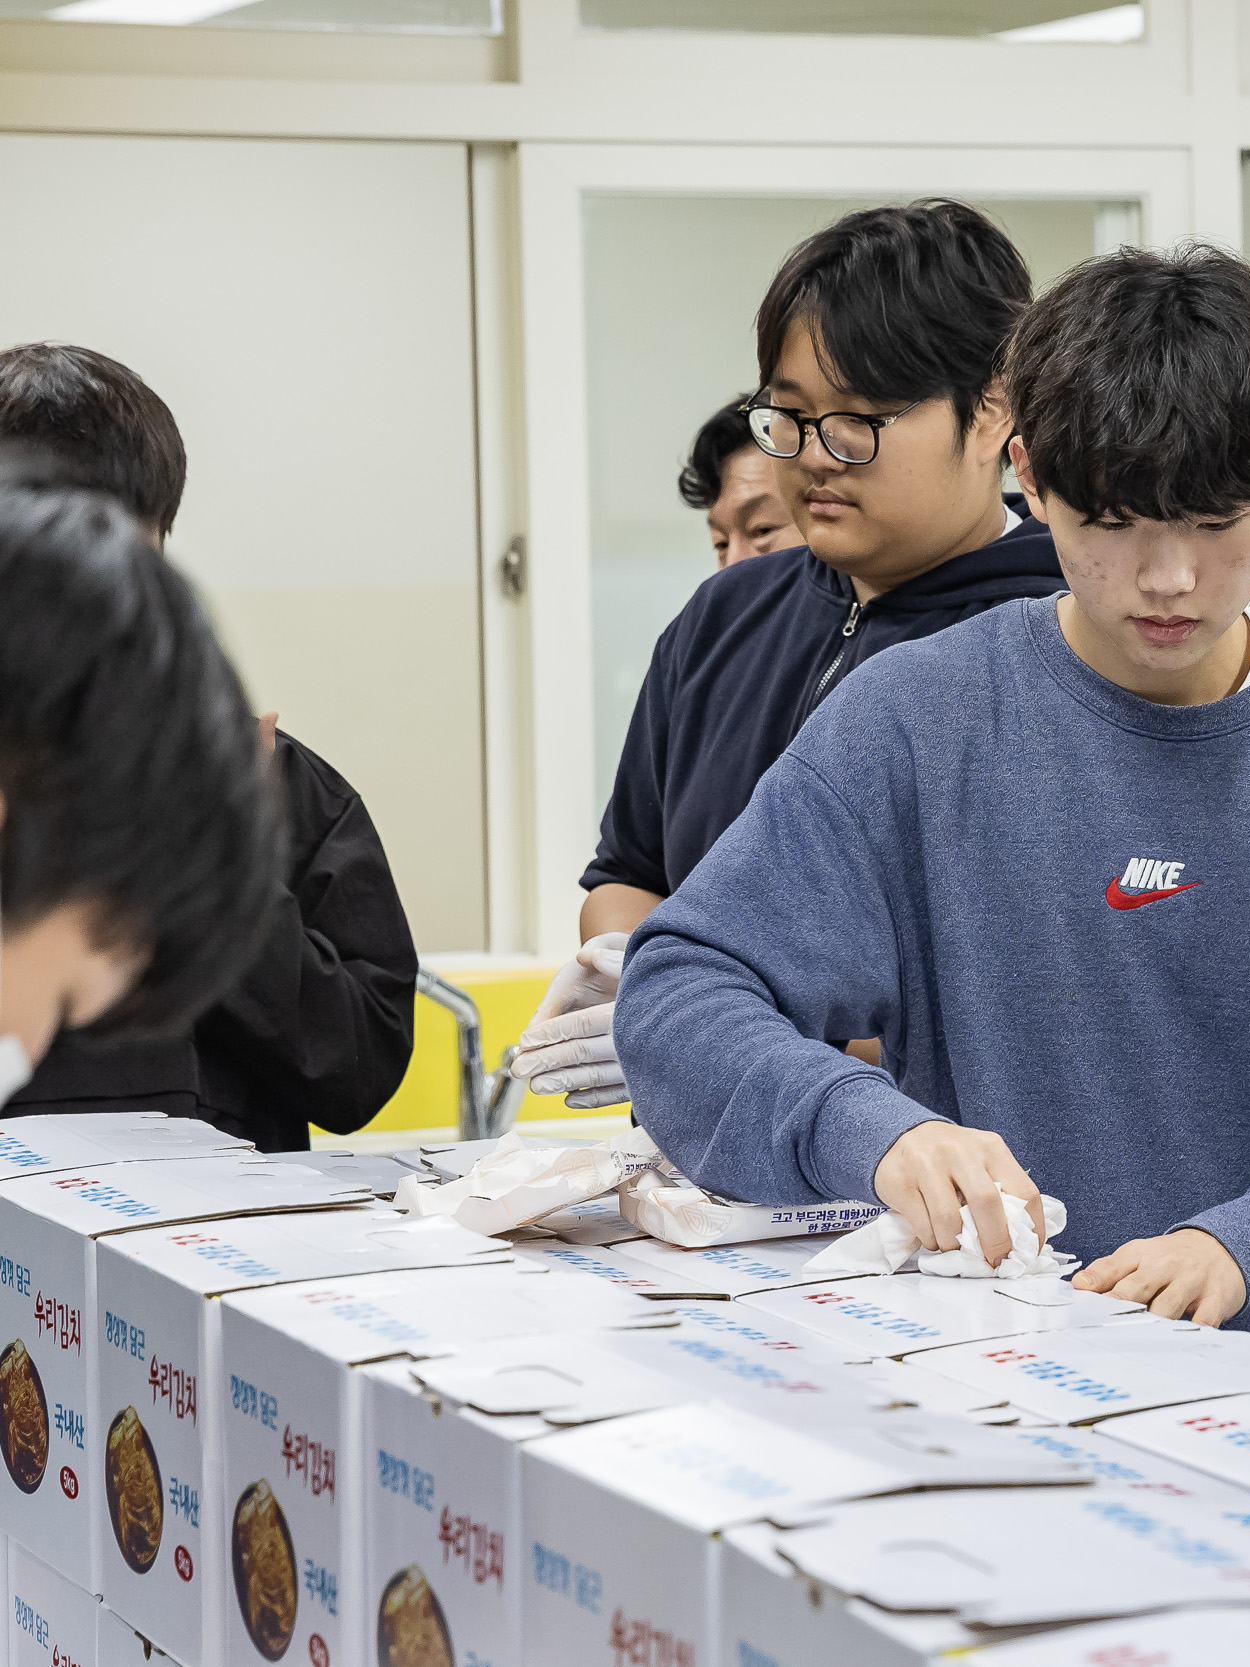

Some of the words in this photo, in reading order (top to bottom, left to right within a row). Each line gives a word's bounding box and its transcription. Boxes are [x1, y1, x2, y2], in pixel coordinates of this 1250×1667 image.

[1120, 858, 1186, 890] NIKE
[771, 1212, 793, 1223] 크고
[795, 1210, 837, 1222] 부드러운
[808, 1223, 818, 1233] 한
[16, 1263, 31, 1298] 담근
[34, 1290, 82, 1359] 우리김치
[129, 1325, 146, 1362] 담근
[148, 1354, 198, 1428] 우리김치
[54, 1403, 85, 1450] 국내산
[281, 1423, 336, 1504] 우리김치
[63, 1469, 76, 1497] 5kg
[168, 1476, 200, 1529] 국내산
[35, 1613, 49, 1651] 담근
